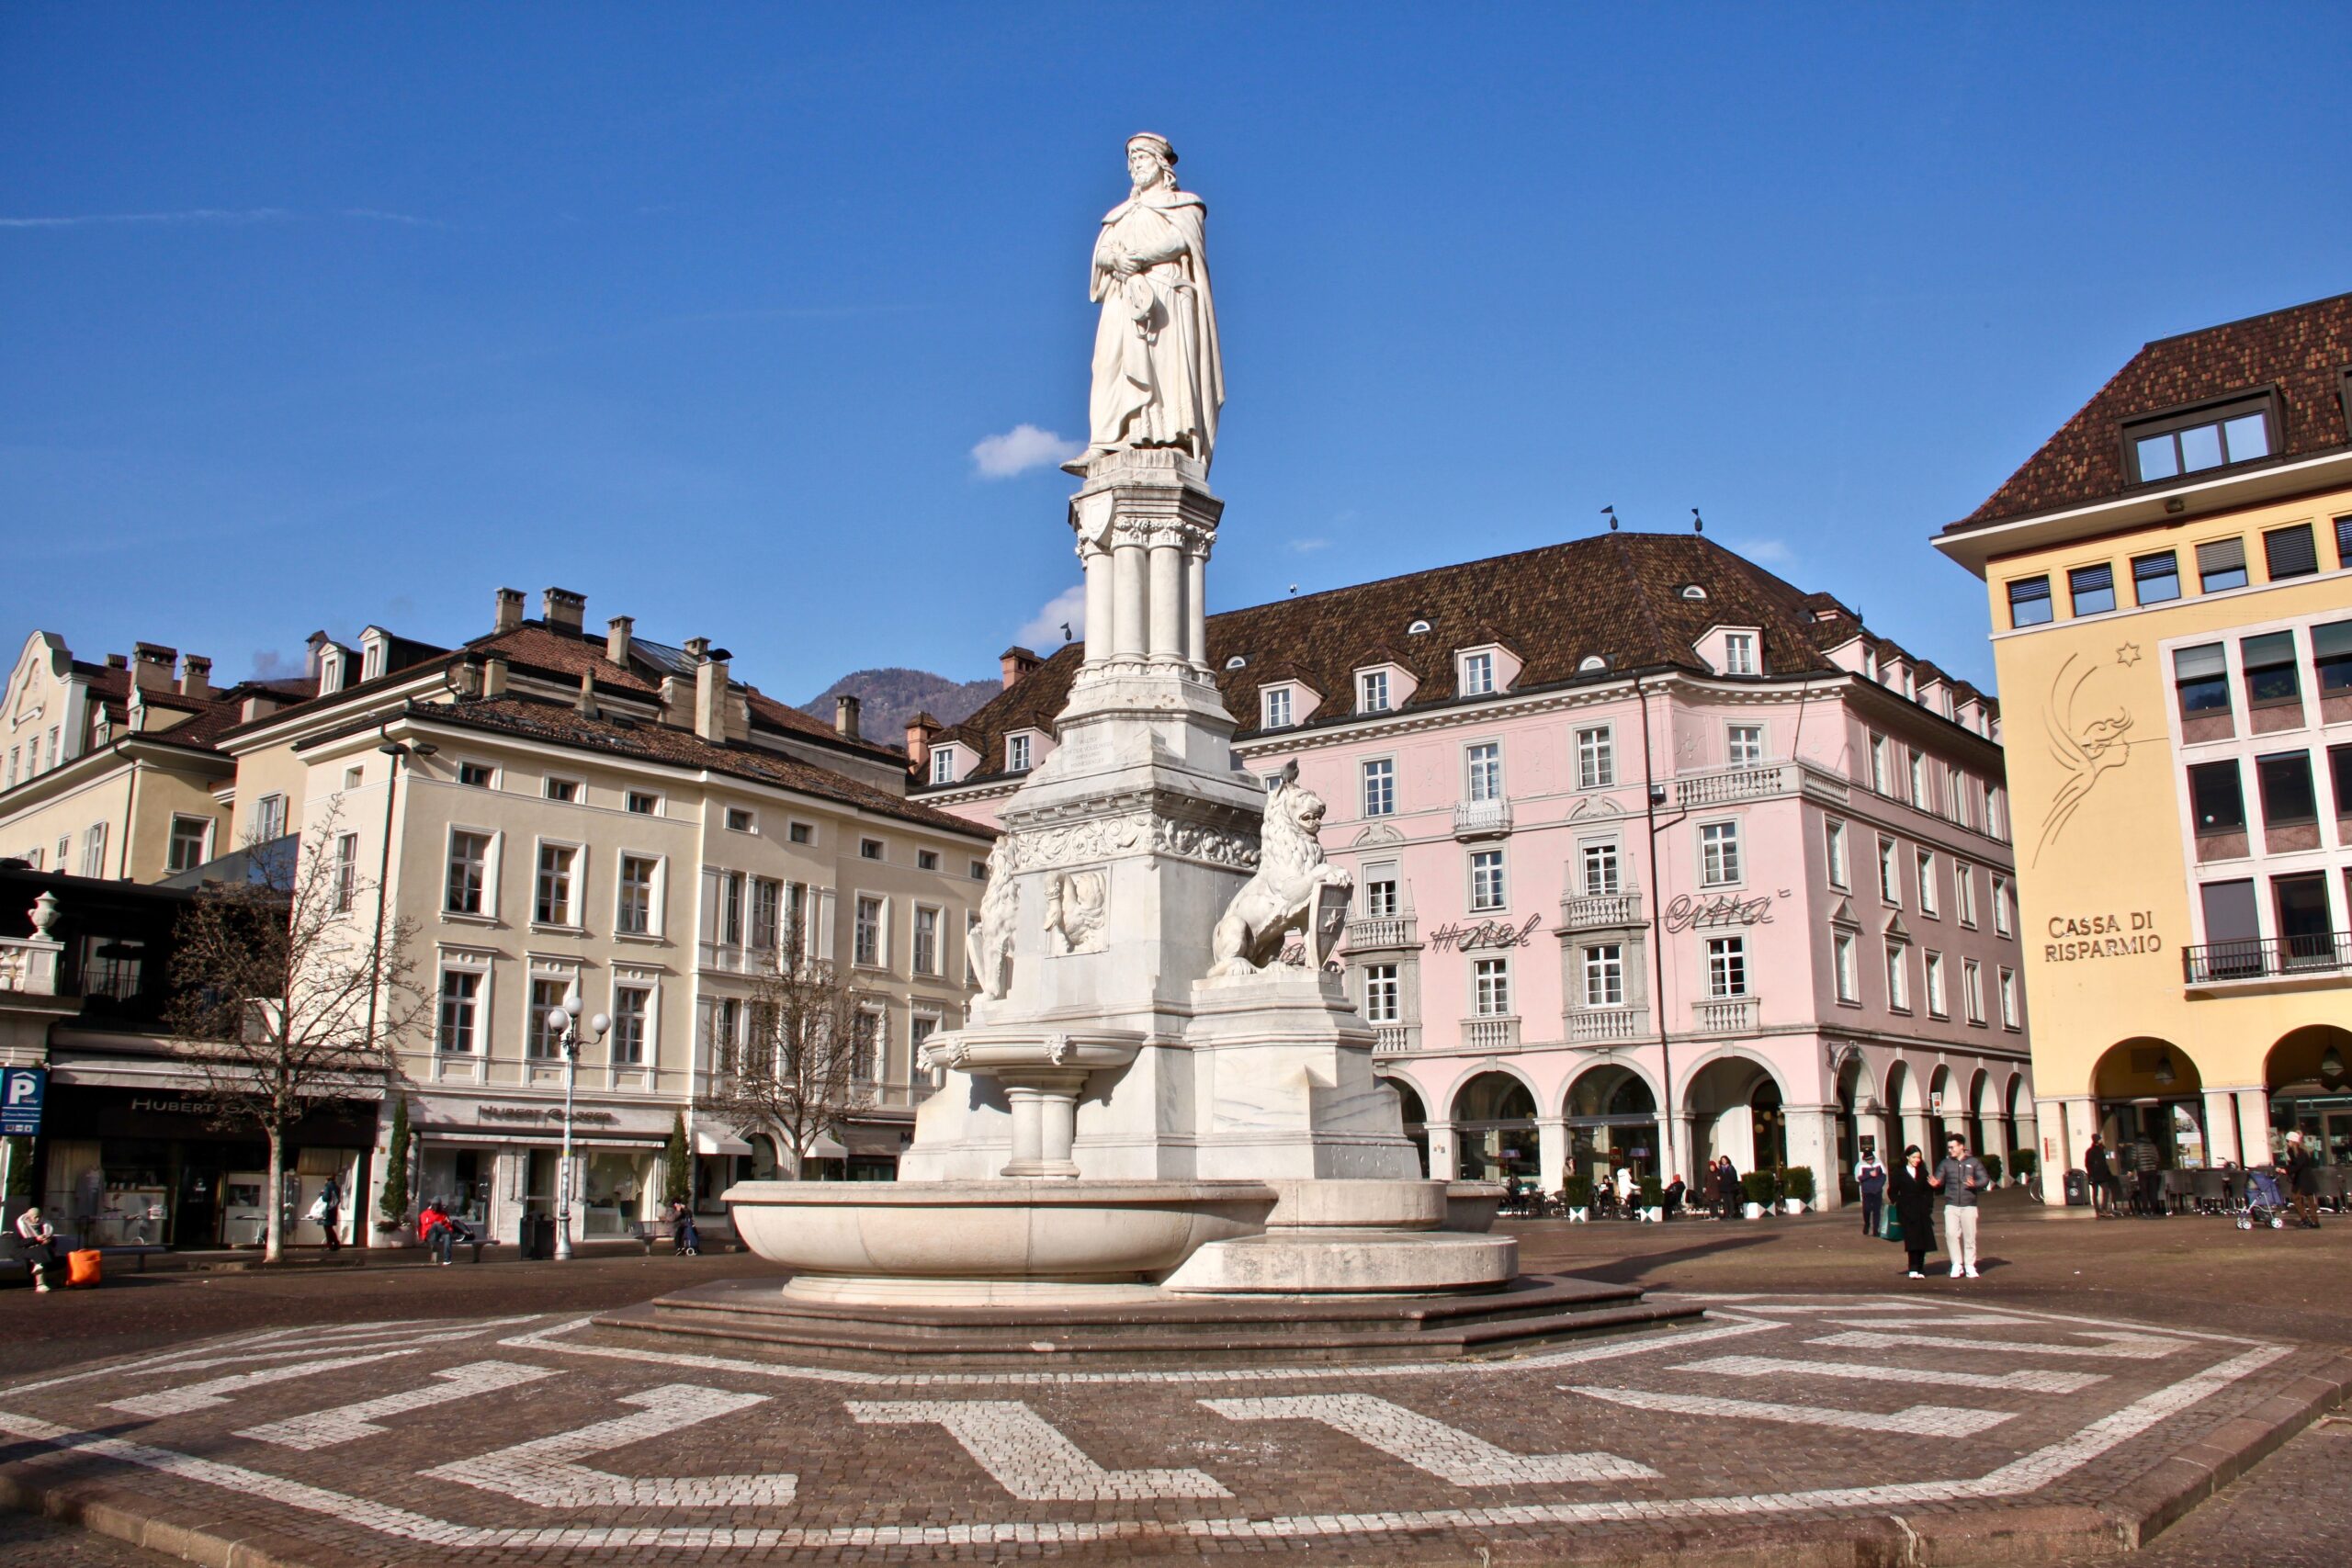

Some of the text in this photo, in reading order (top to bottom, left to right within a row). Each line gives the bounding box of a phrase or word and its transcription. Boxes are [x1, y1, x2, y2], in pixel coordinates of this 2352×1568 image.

[1430, 913, 1542, 953] Hotel
[2048, 910, 2153, 939] CASSA DI
[2044, 933, 2162, 963] RISPARMIO
[9, 1078, 36, 1104] P
[131, 1098, 215, 1114] HUBERT
